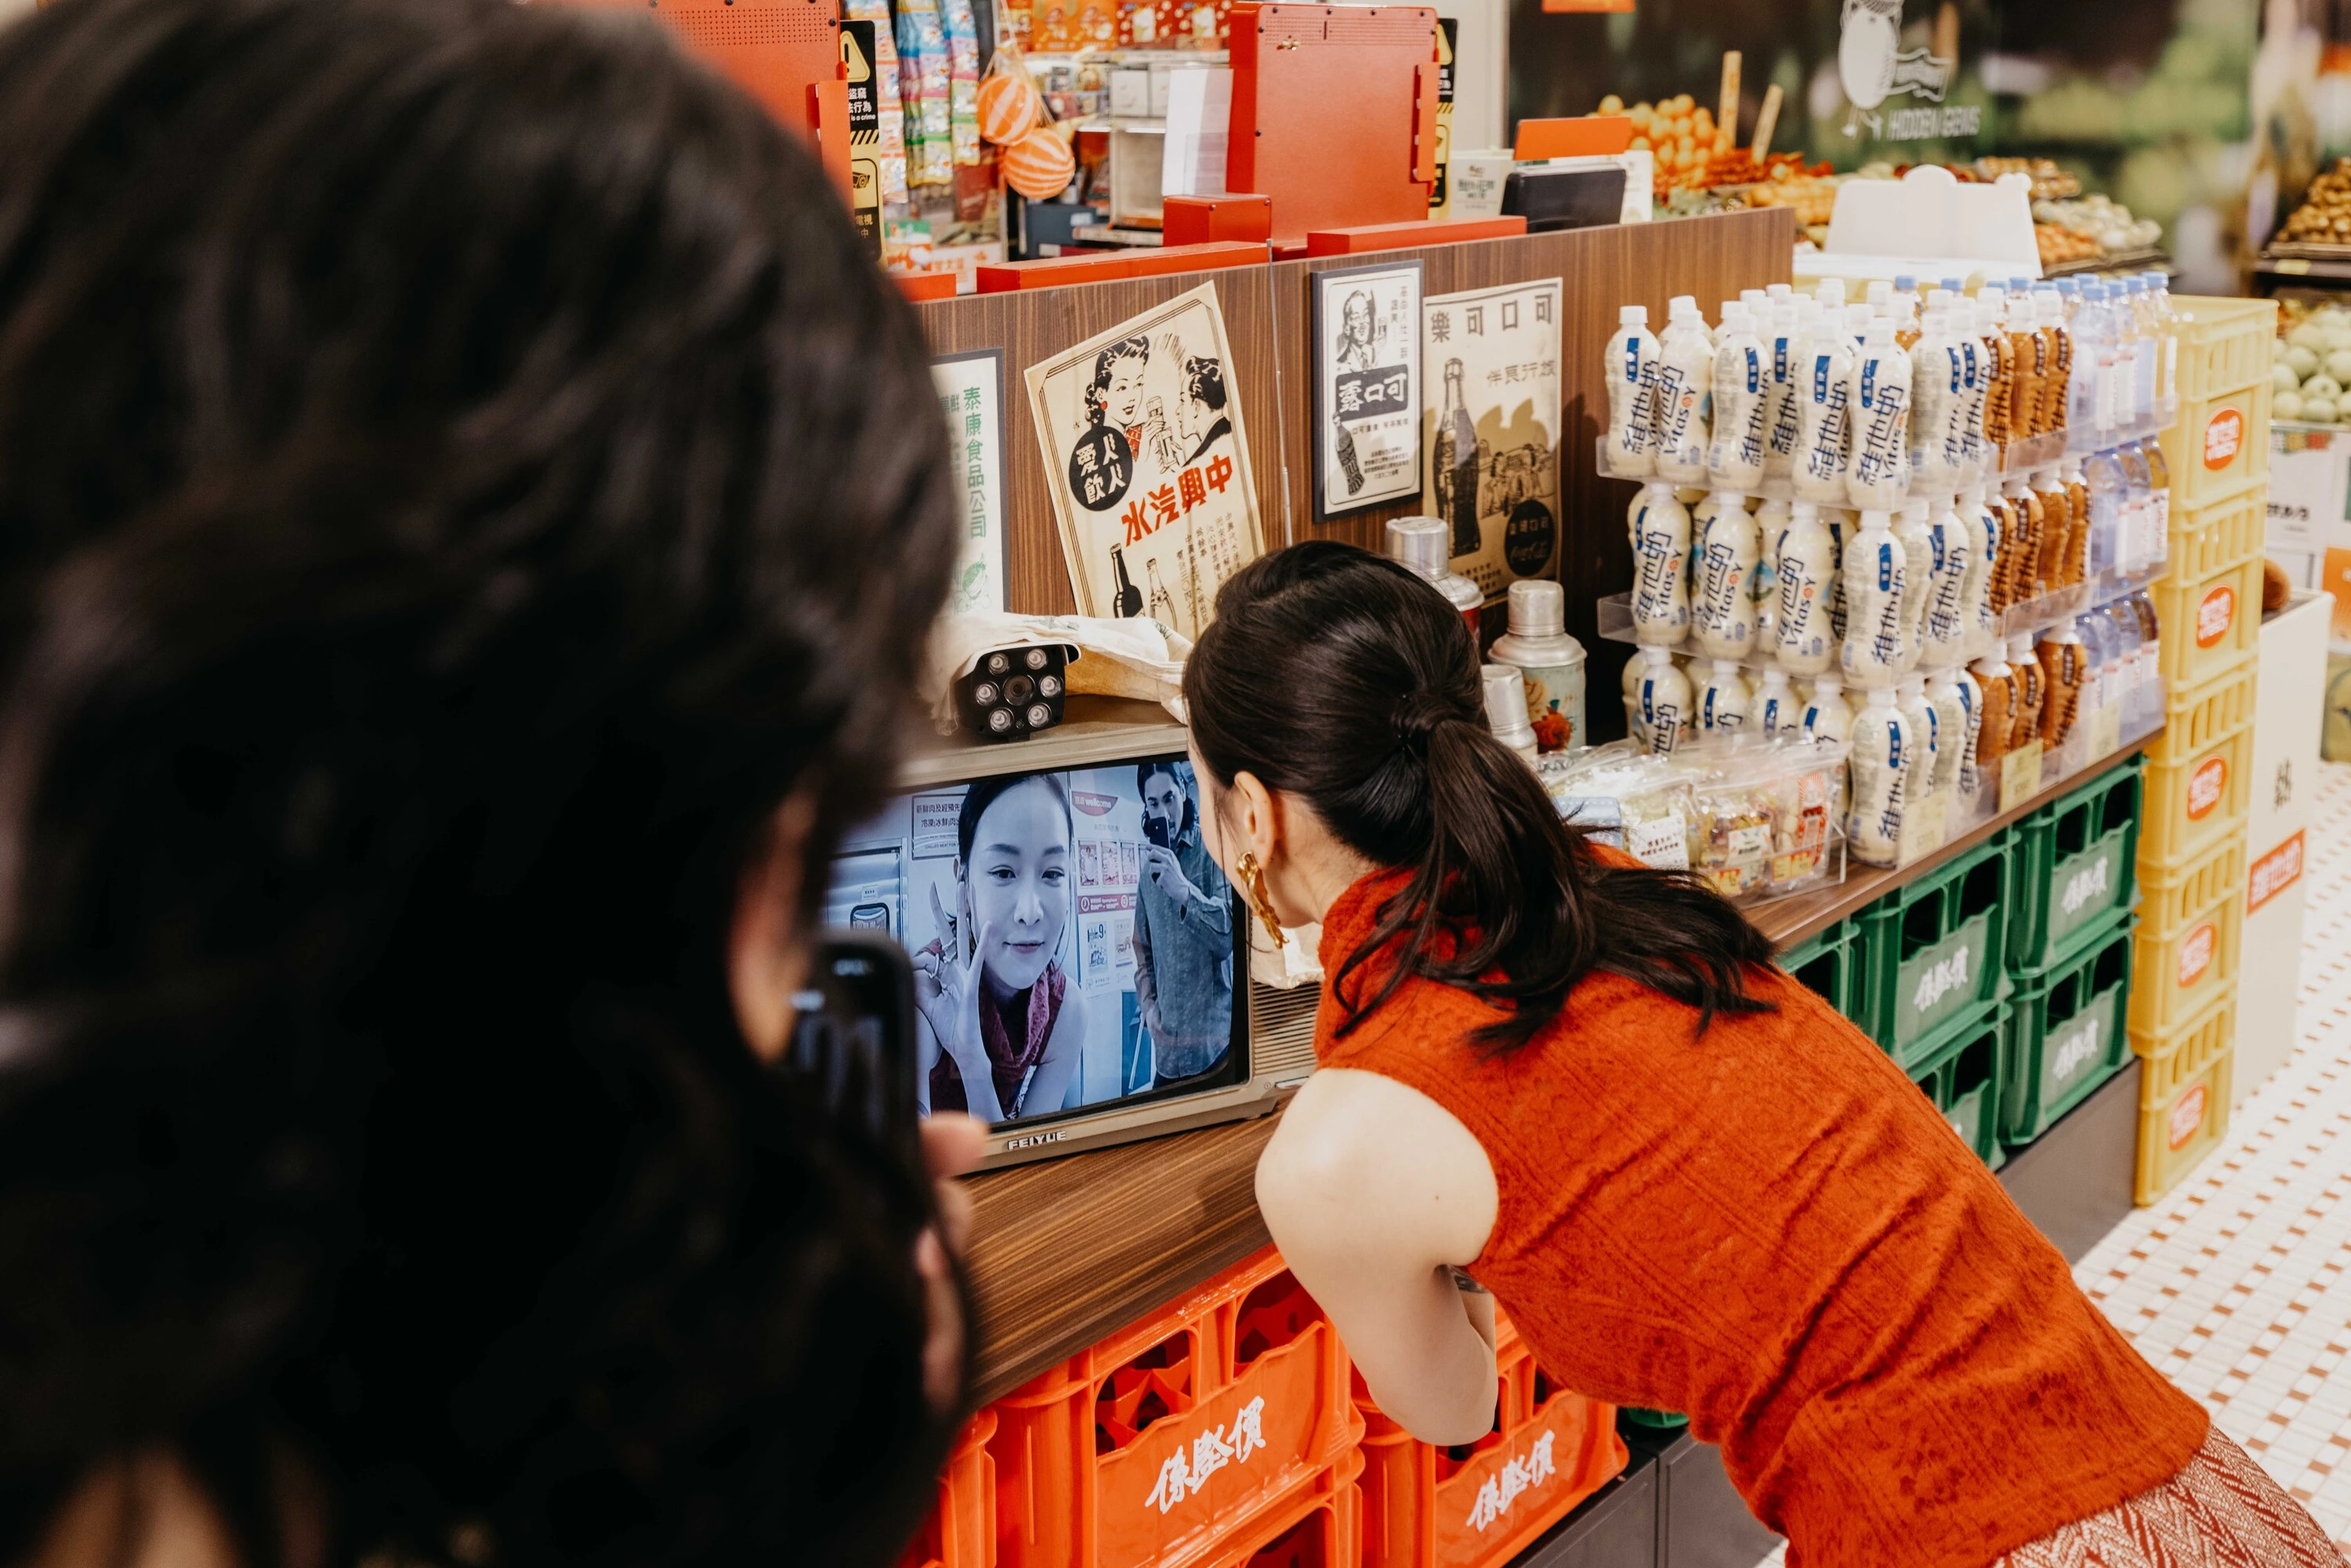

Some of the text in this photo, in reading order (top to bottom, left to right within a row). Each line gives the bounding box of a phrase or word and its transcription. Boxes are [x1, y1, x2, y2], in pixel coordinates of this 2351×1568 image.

[963, 386, 987, 539] 泰康食品公司
[1008, 1131, 1067, 1150] FEIYUE
